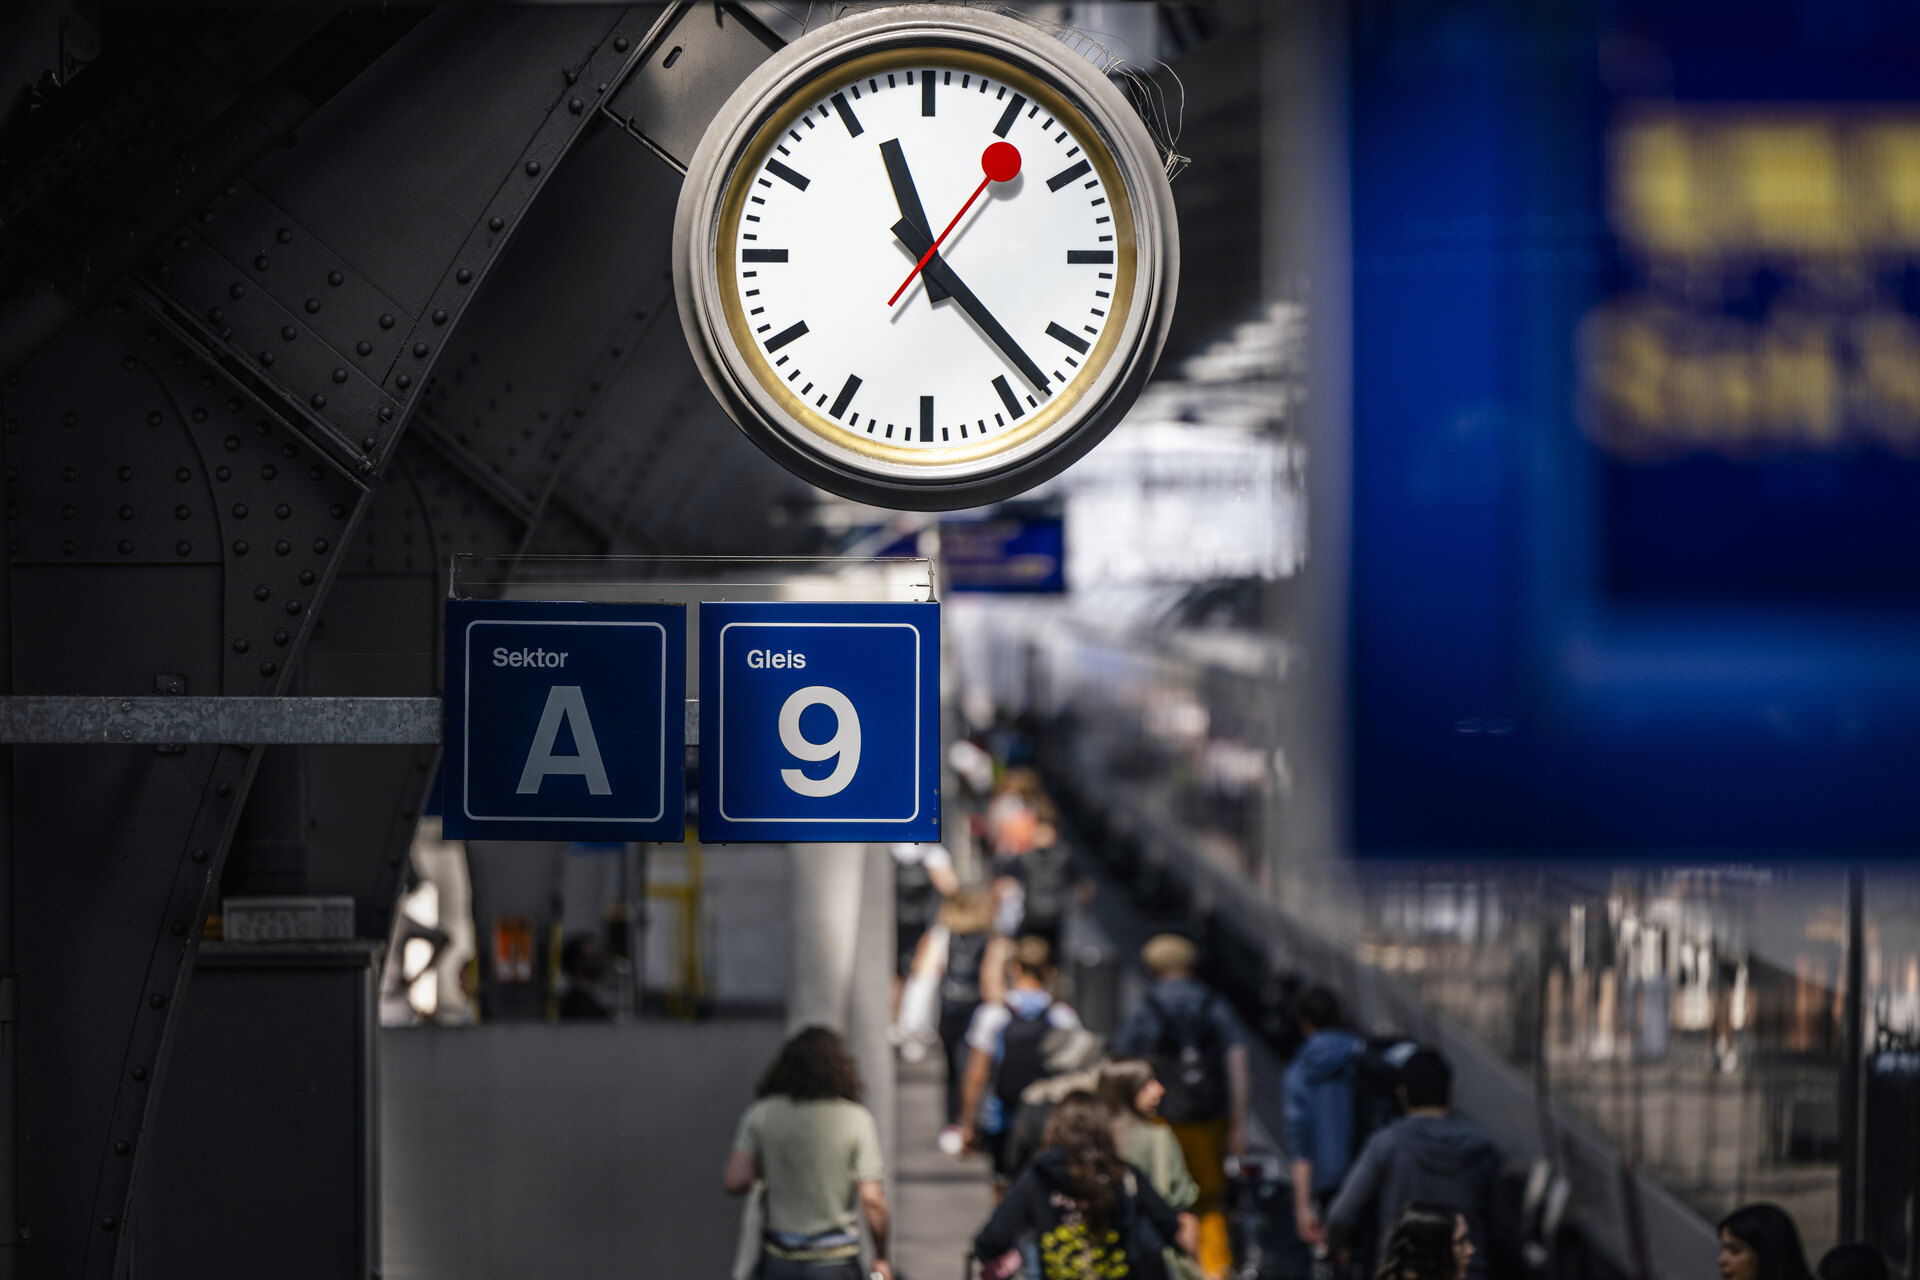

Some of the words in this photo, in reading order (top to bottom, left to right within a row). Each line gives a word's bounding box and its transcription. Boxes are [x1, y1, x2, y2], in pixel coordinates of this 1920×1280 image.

[492, 647, 569, 668] Sektor
[746, 649, 807, 669] Gleis
[516, 685, 613, 796] A
[778, 685, 862, 798] 9
